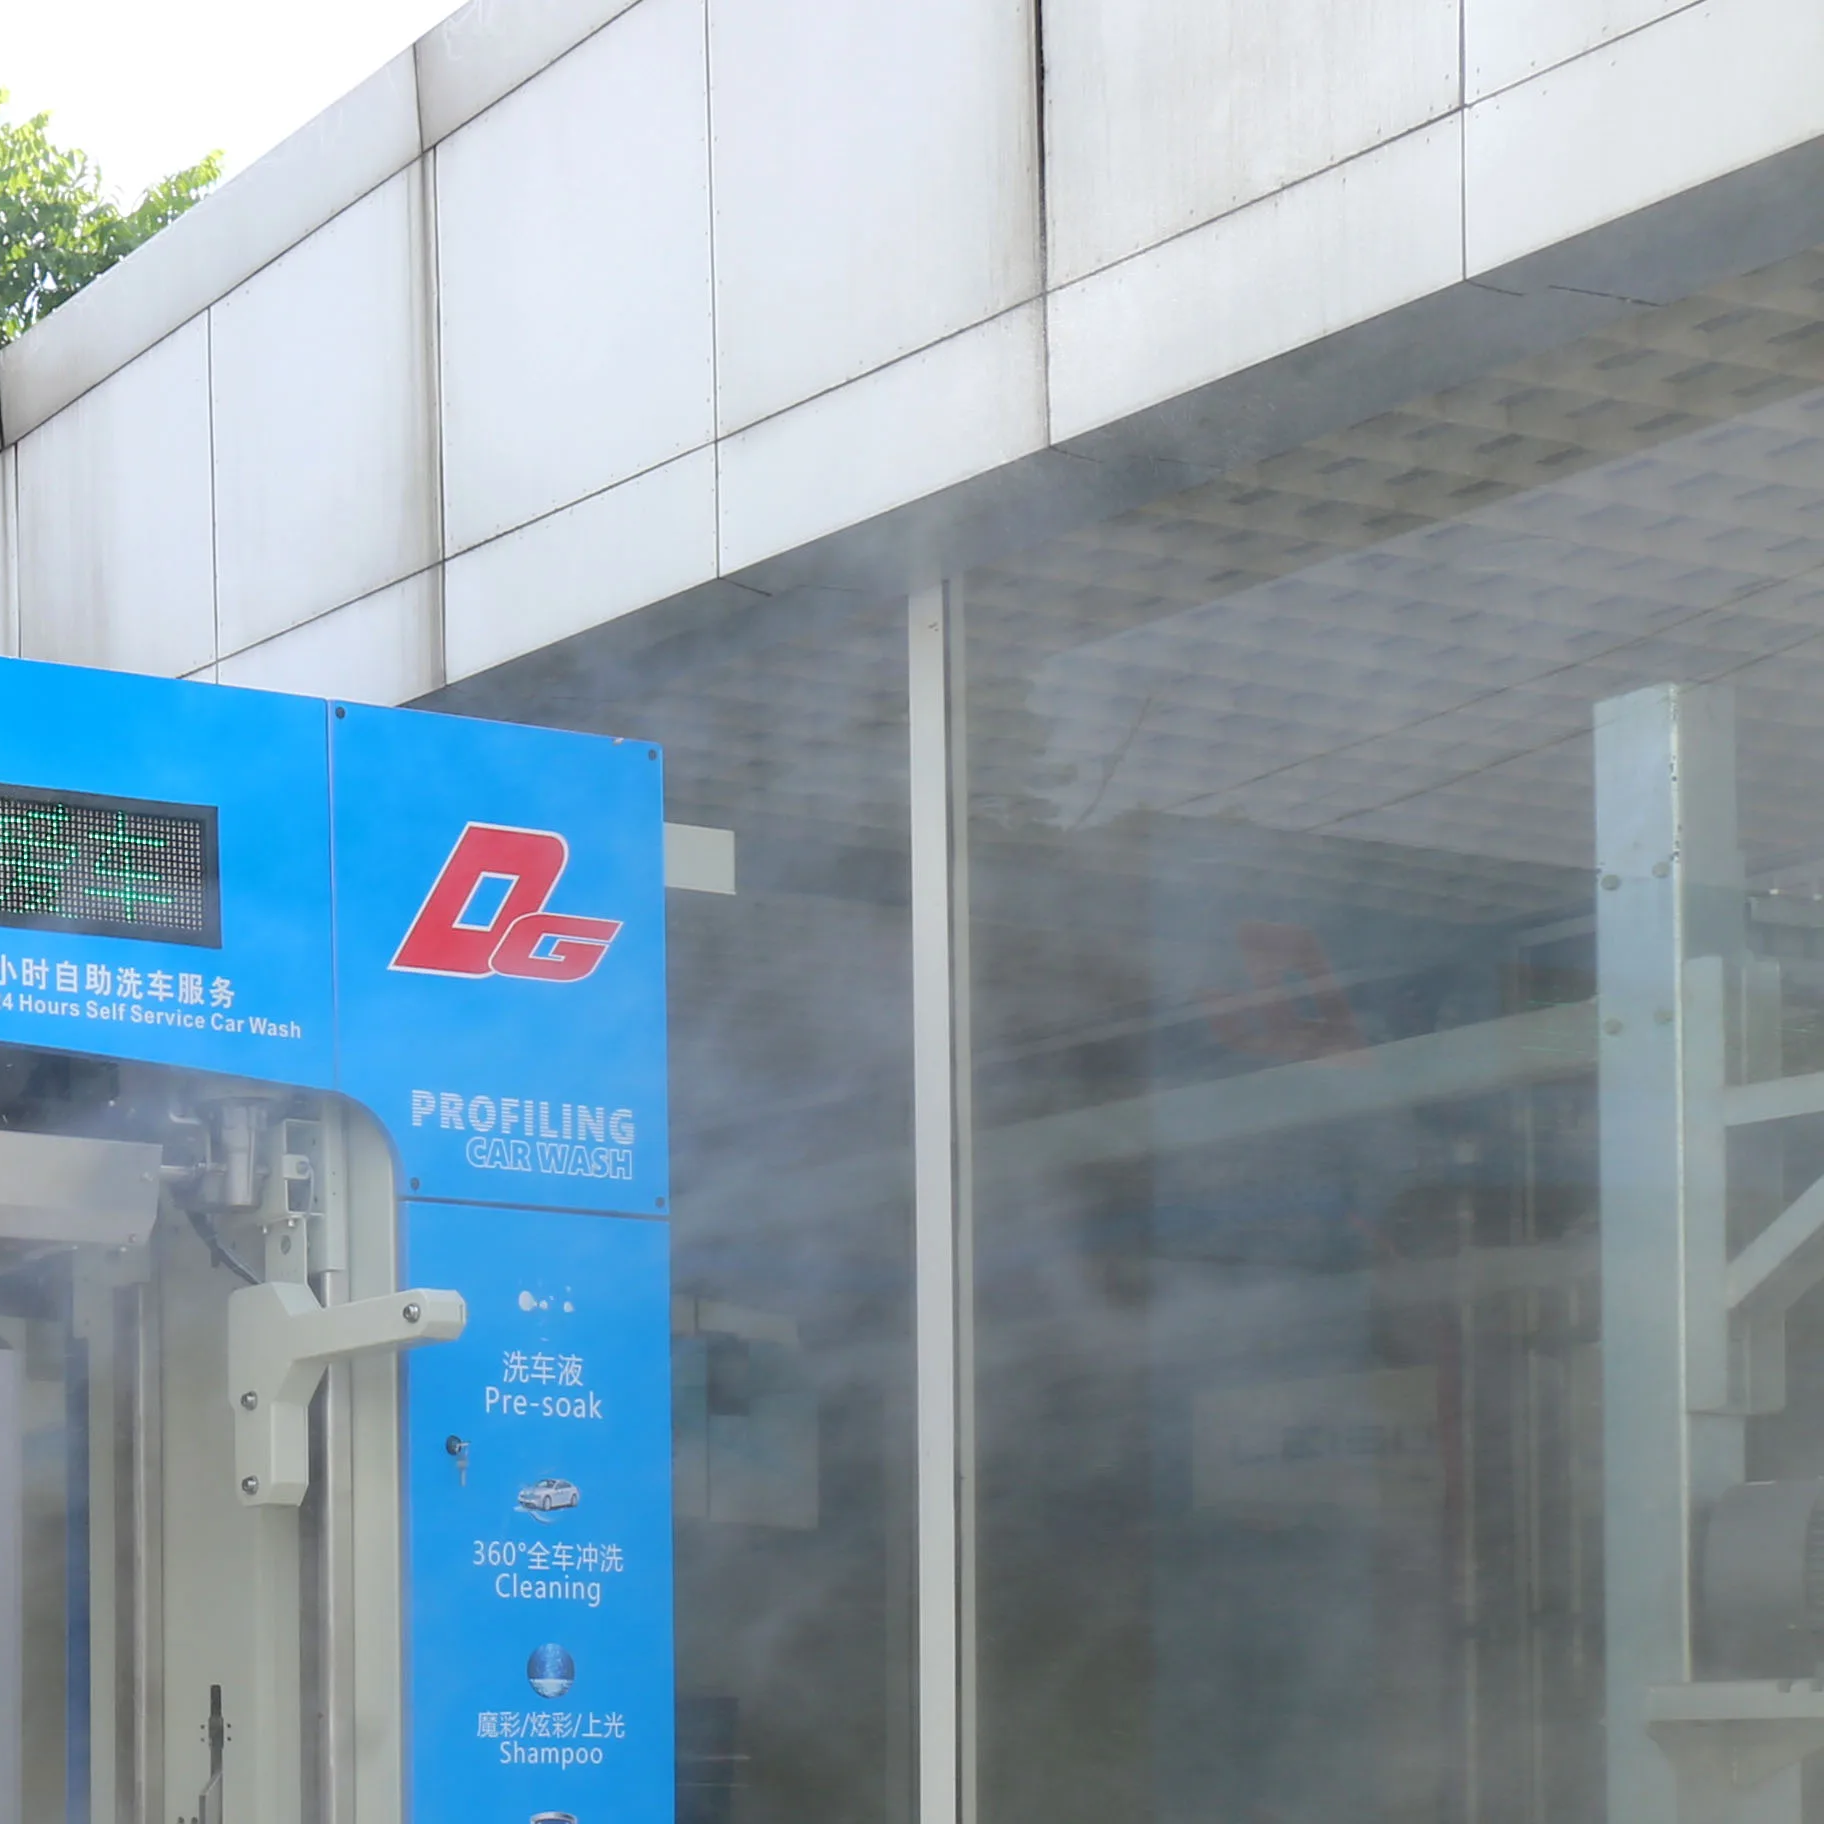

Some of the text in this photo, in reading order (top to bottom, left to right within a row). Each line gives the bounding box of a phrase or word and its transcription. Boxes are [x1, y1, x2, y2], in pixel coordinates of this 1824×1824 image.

[19, 994, 80, 1017] Hours
[86, 999, 126, 1020] Self
[130, 1005, 205, 1029] Service
[211, 1012, 244, 1032] Car
[249, 1017, 302, 1039] Wash
[412, 1089, 635, 1145] PROFILING
[466, 1136, 633, 1180] CAR WASH
[502, 1350, 584, 1387] 洗车液
[485, 1386, 602, 1419] Pre-soak
[495, 1574, 601, 1607] Cleaning
[499, 1741, 604, 1770] Shampoo
